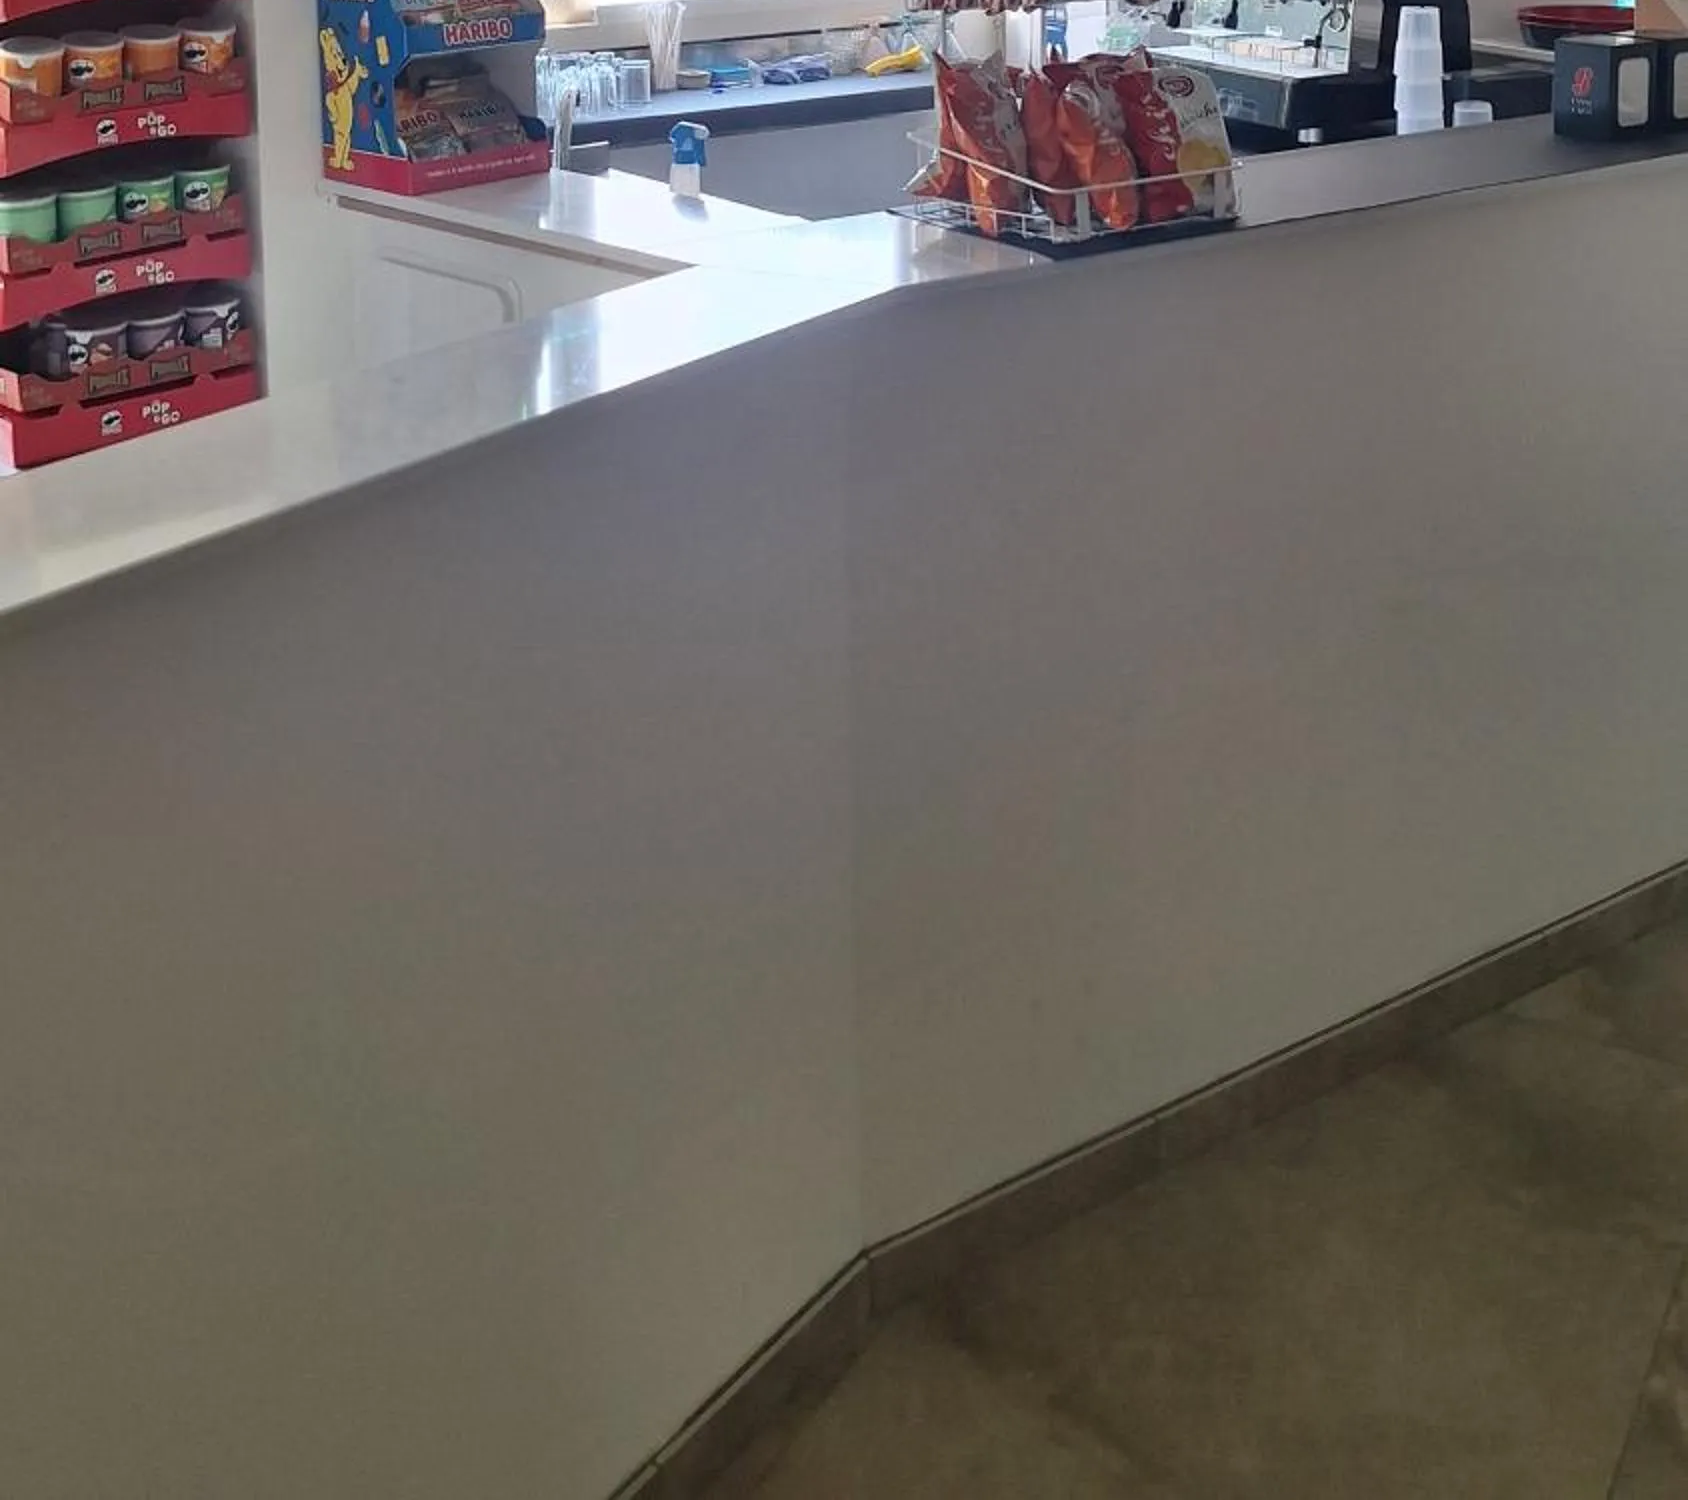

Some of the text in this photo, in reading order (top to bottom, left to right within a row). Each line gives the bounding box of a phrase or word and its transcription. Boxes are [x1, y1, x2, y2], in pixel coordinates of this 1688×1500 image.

[443, 17, 512, 46] HARIBO
[138, 111, 165, 129] POP
[400, 109, 438, 131] RIBO
[136, 259, 164, 276] POP
[142, 400, 170, 418] POP
